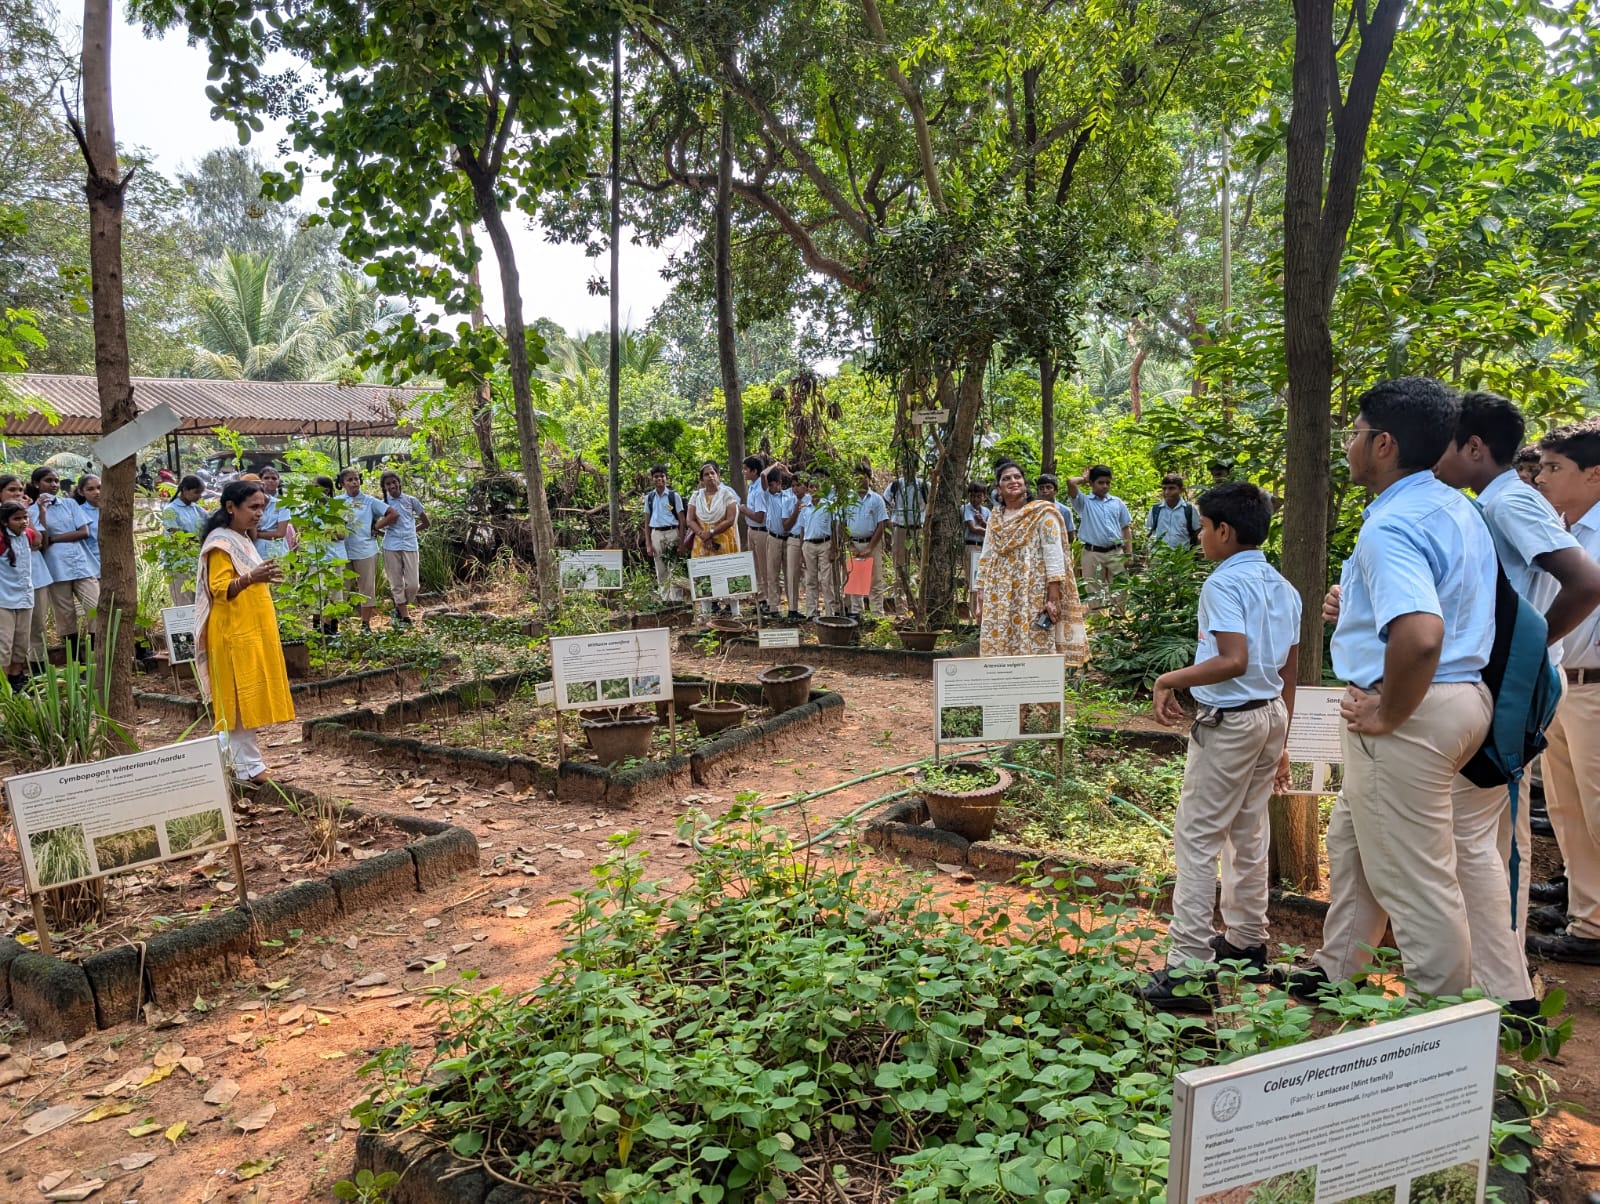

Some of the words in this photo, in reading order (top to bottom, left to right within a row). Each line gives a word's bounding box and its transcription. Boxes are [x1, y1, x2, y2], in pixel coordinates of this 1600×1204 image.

[58, 768, 111, 786] Cymbopogon
[112, 752, 186, 773] winterianus/nardus
[1263, 1055, 1377, 1093] Coleus/Plectranthus
[1380, 1039, 1441, 1063] amboinicus
[1316, 1084, 1350, 1098] Lamiaceae
